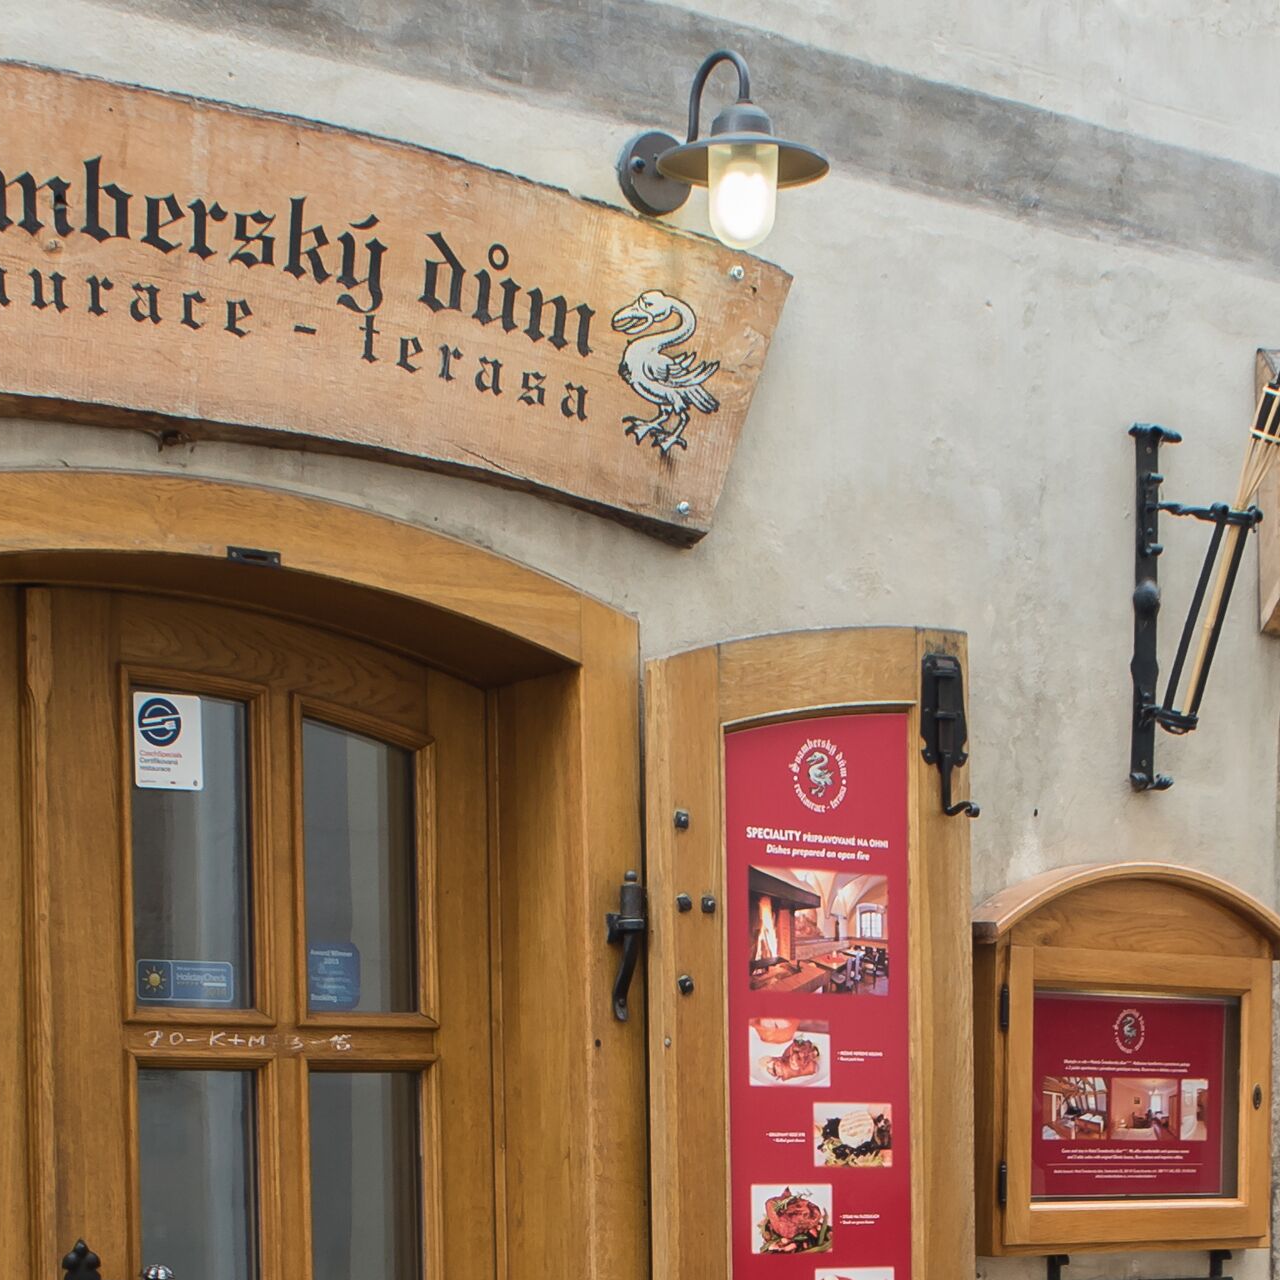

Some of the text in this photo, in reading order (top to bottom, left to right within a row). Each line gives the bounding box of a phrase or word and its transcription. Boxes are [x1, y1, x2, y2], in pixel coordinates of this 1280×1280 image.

[419, 232, 594, 357] dům
[361, 315, 589, 421] terasa
[746, 826, 801, 841] SPECIALITY
[857, 838, 868, 847] NA
[766, 843, 791, 855] Dishes
[791, 846, 826, 858] prepared
[837, 851, 856, 861] open
[856, 850, 870, 861] fire
